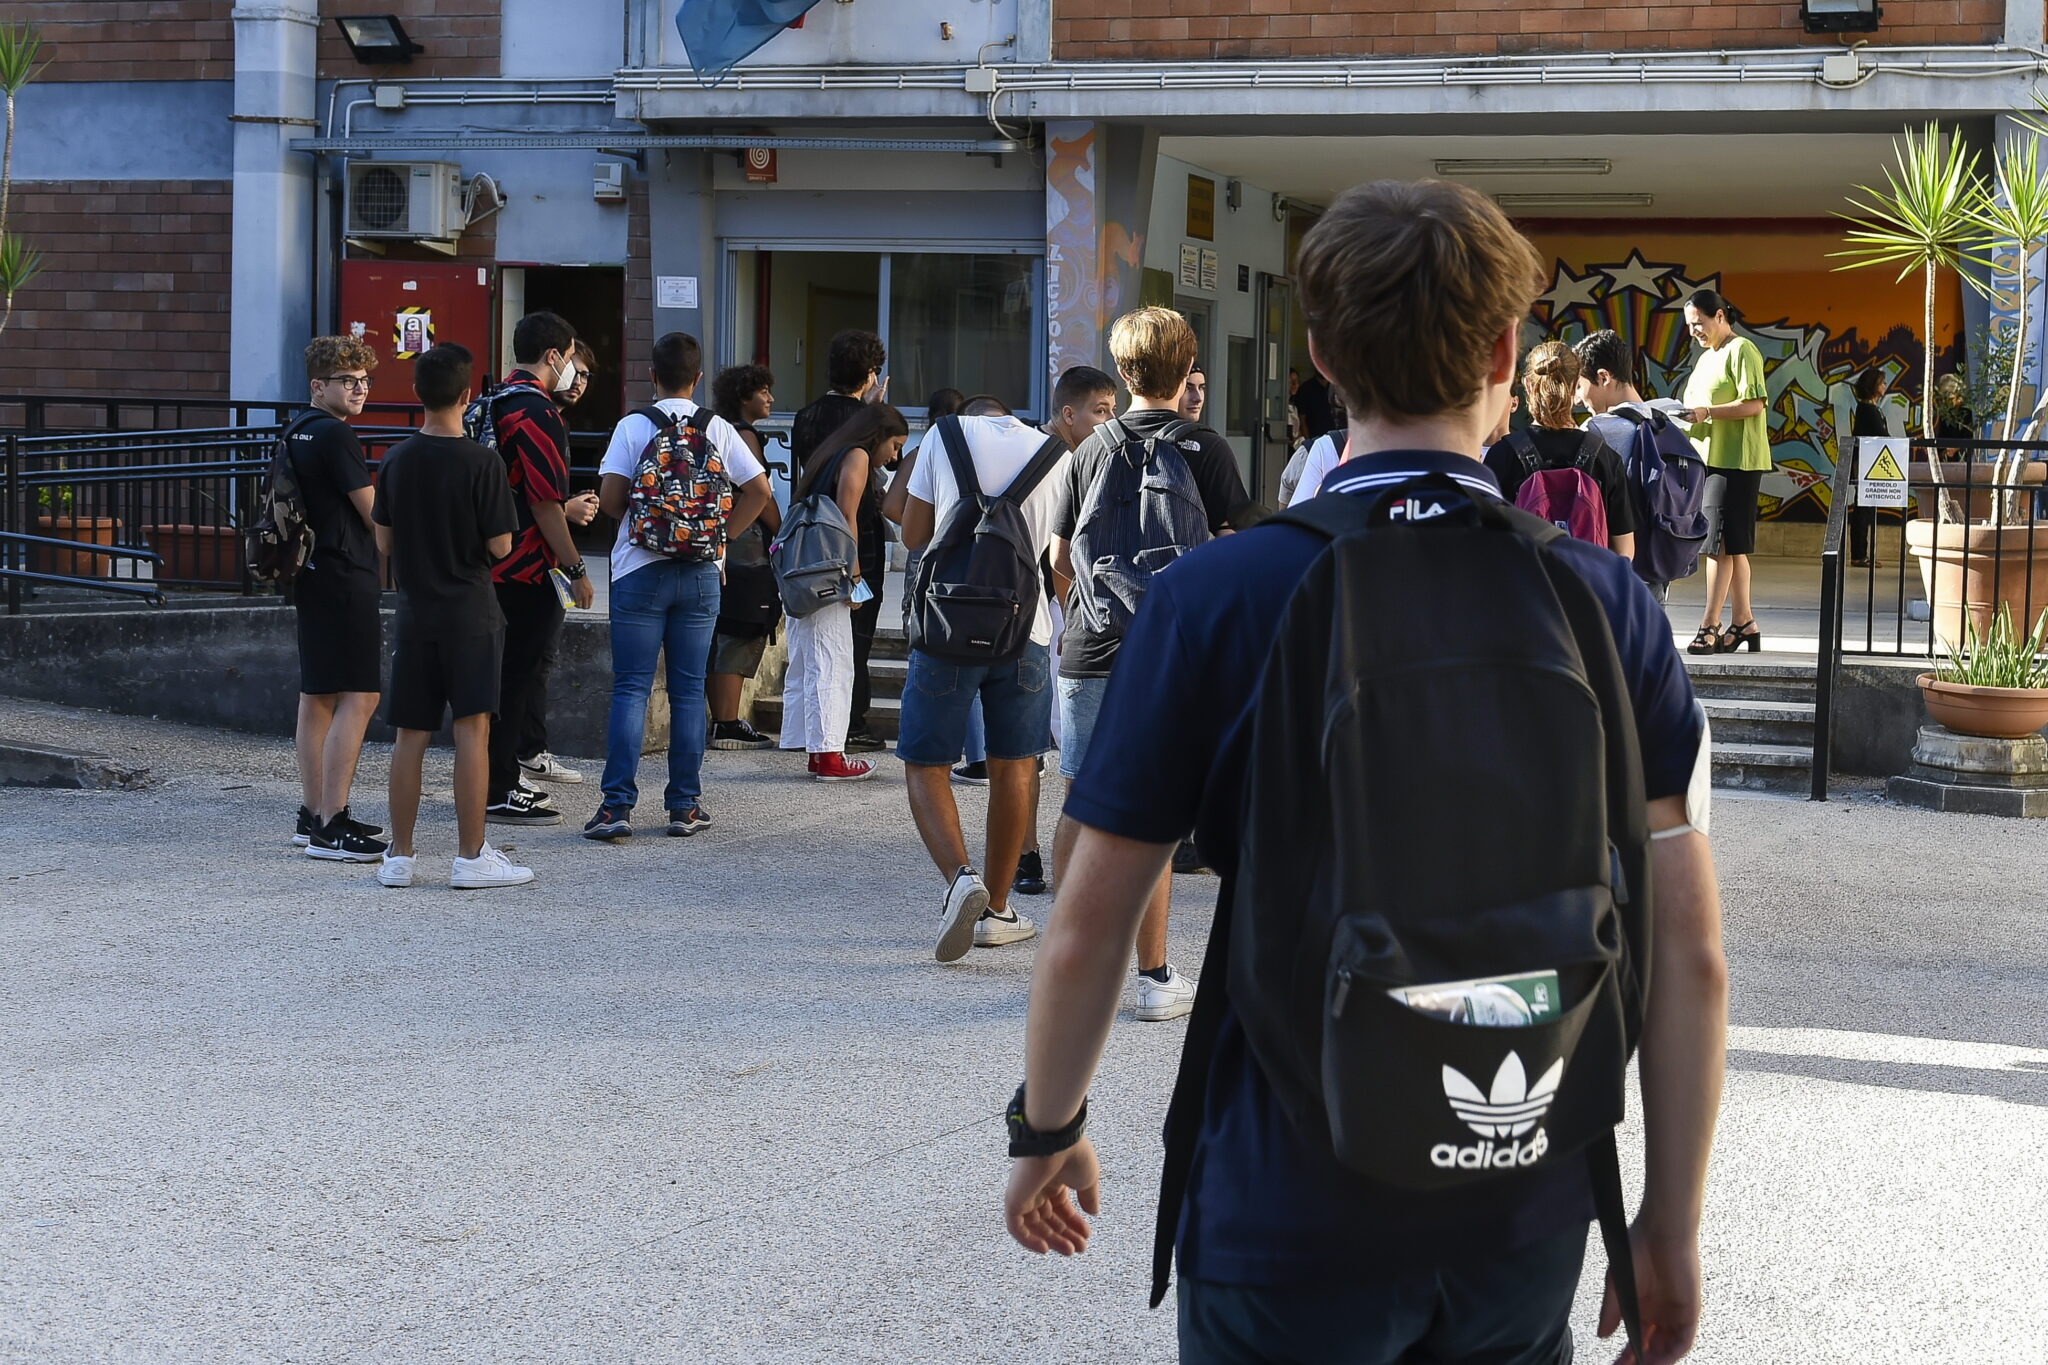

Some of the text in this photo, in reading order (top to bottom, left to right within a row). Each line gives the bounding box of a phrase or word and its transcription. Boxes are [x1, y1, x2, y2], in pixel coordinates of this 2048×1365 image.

[407, 318, 420, 331] a
[1390, 498, 1446, 520] FILA
[1430, 1127, 1549, 1169] adidas
